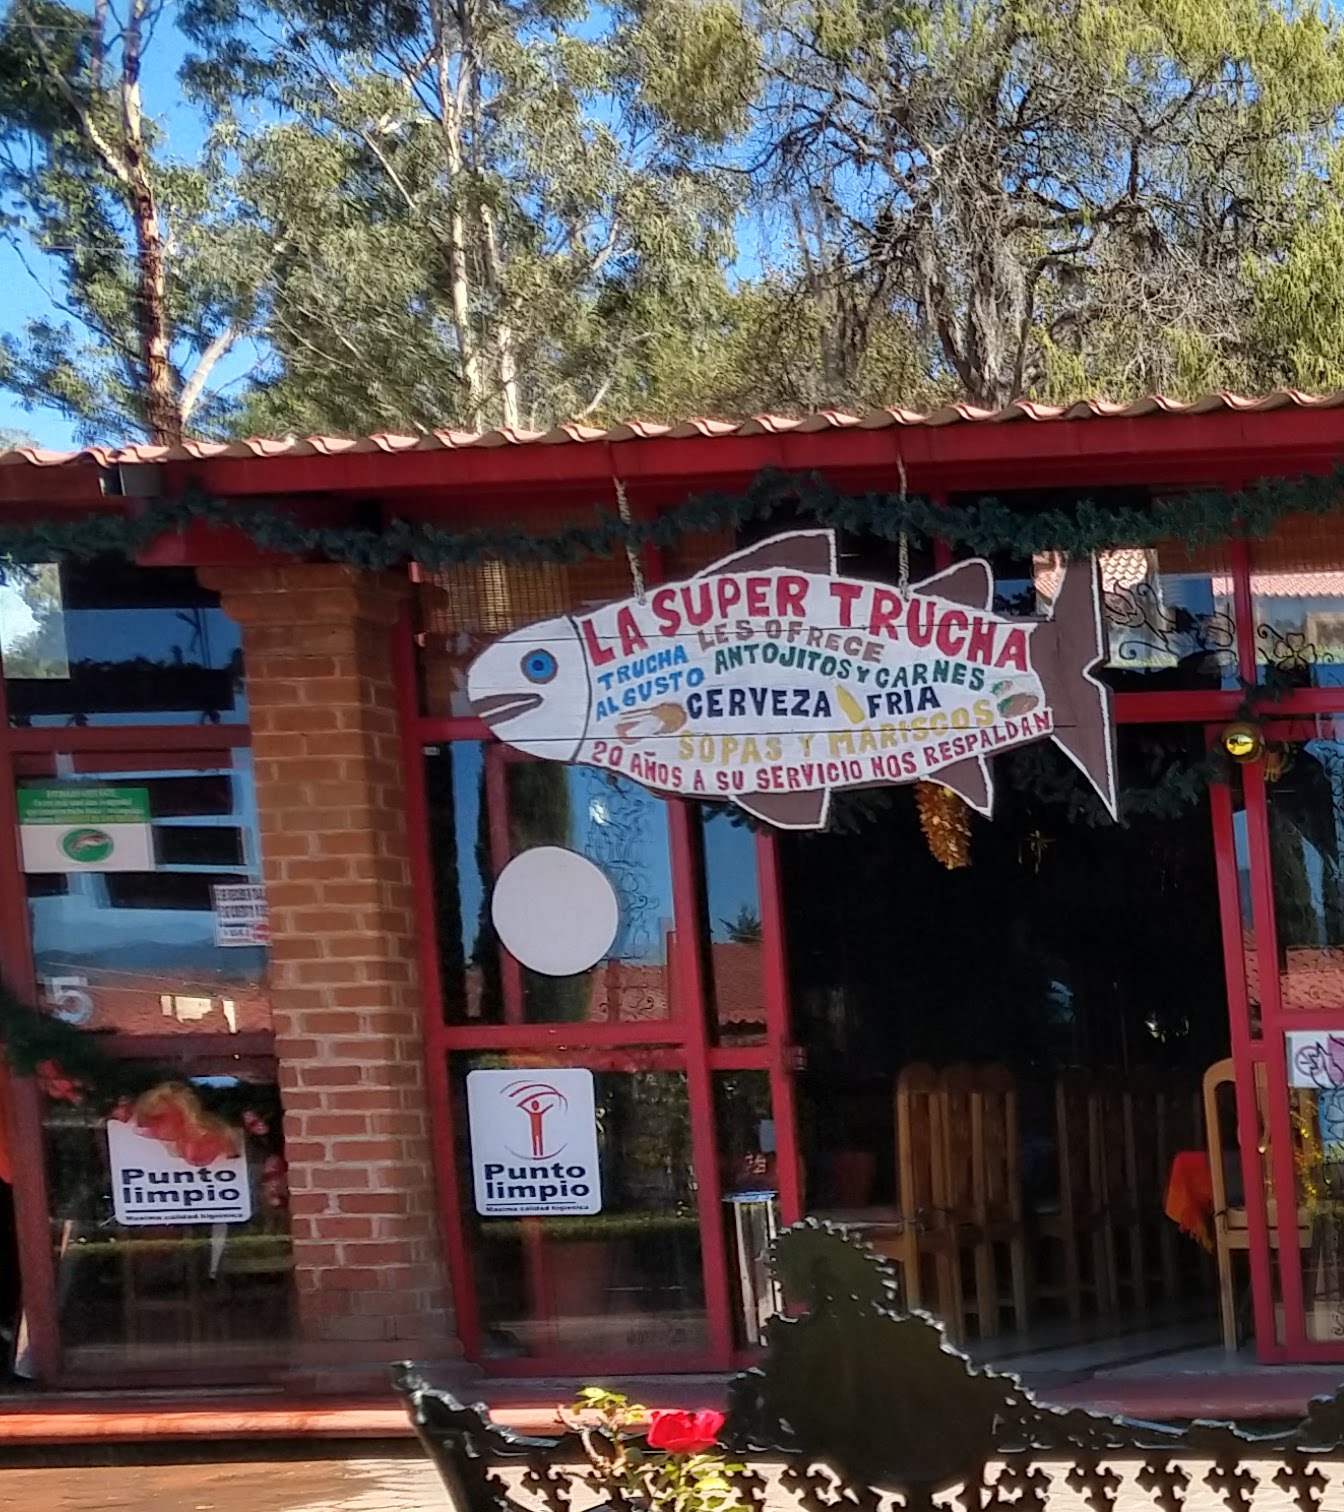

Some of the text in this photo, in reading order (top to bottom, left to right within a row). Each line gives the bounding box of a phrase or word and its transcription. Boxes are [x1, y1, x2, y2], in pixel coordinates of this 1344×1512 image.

[582, 575, 1029, 673] LA SUPER TRUCHA
[698, 619, 885, 664] LES OFRECE
[597, 644, 689, 692] TRUCHA
[714, 642, 986, 692] ANTOJITOS Y CARNES
[595, 667, 705, 722] AL GUSTO
[686, 685, 942, 720] CERVEZA FRIA
[592, 709, 1053, 792] 20 AÑOS A SU SERVICIO NOS RESPALDAN
[677, 699, 995, 767] SOPAS Y MARISCOS
[121, 1168, 236, 1185] Punto
[484, 1163, 586, 1180] Punto
[486, 1181, 589, 1201] limpio
[123, 1185, 240, 1206] limpio
